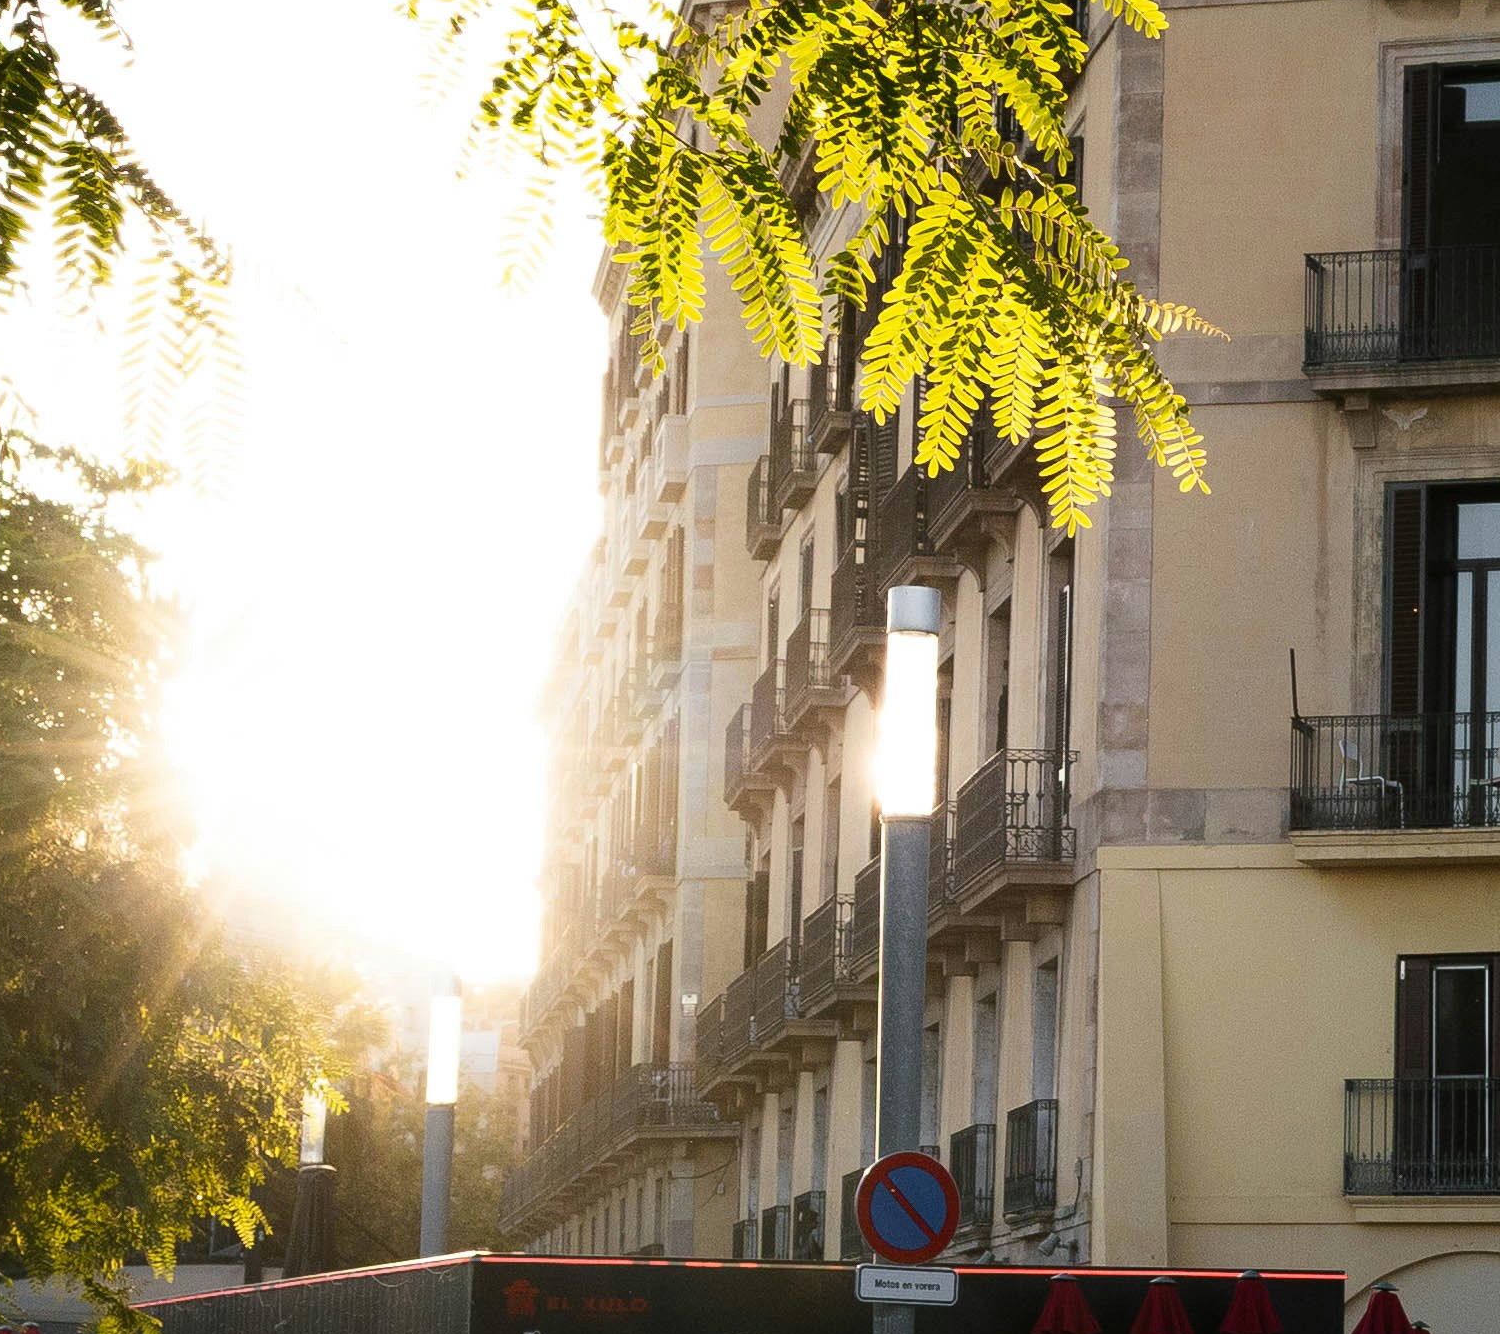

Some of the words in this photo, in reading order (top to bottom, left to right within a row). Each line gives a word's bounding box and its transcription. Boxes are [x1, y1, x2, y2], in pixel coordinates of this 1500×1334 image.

[874, 1279, 900, 1289] Motos
[914, 1283, 941, 1292] vorera
[547, 1296, 571, 1313] EL
[581, 1295, 650, 1314] XULO
